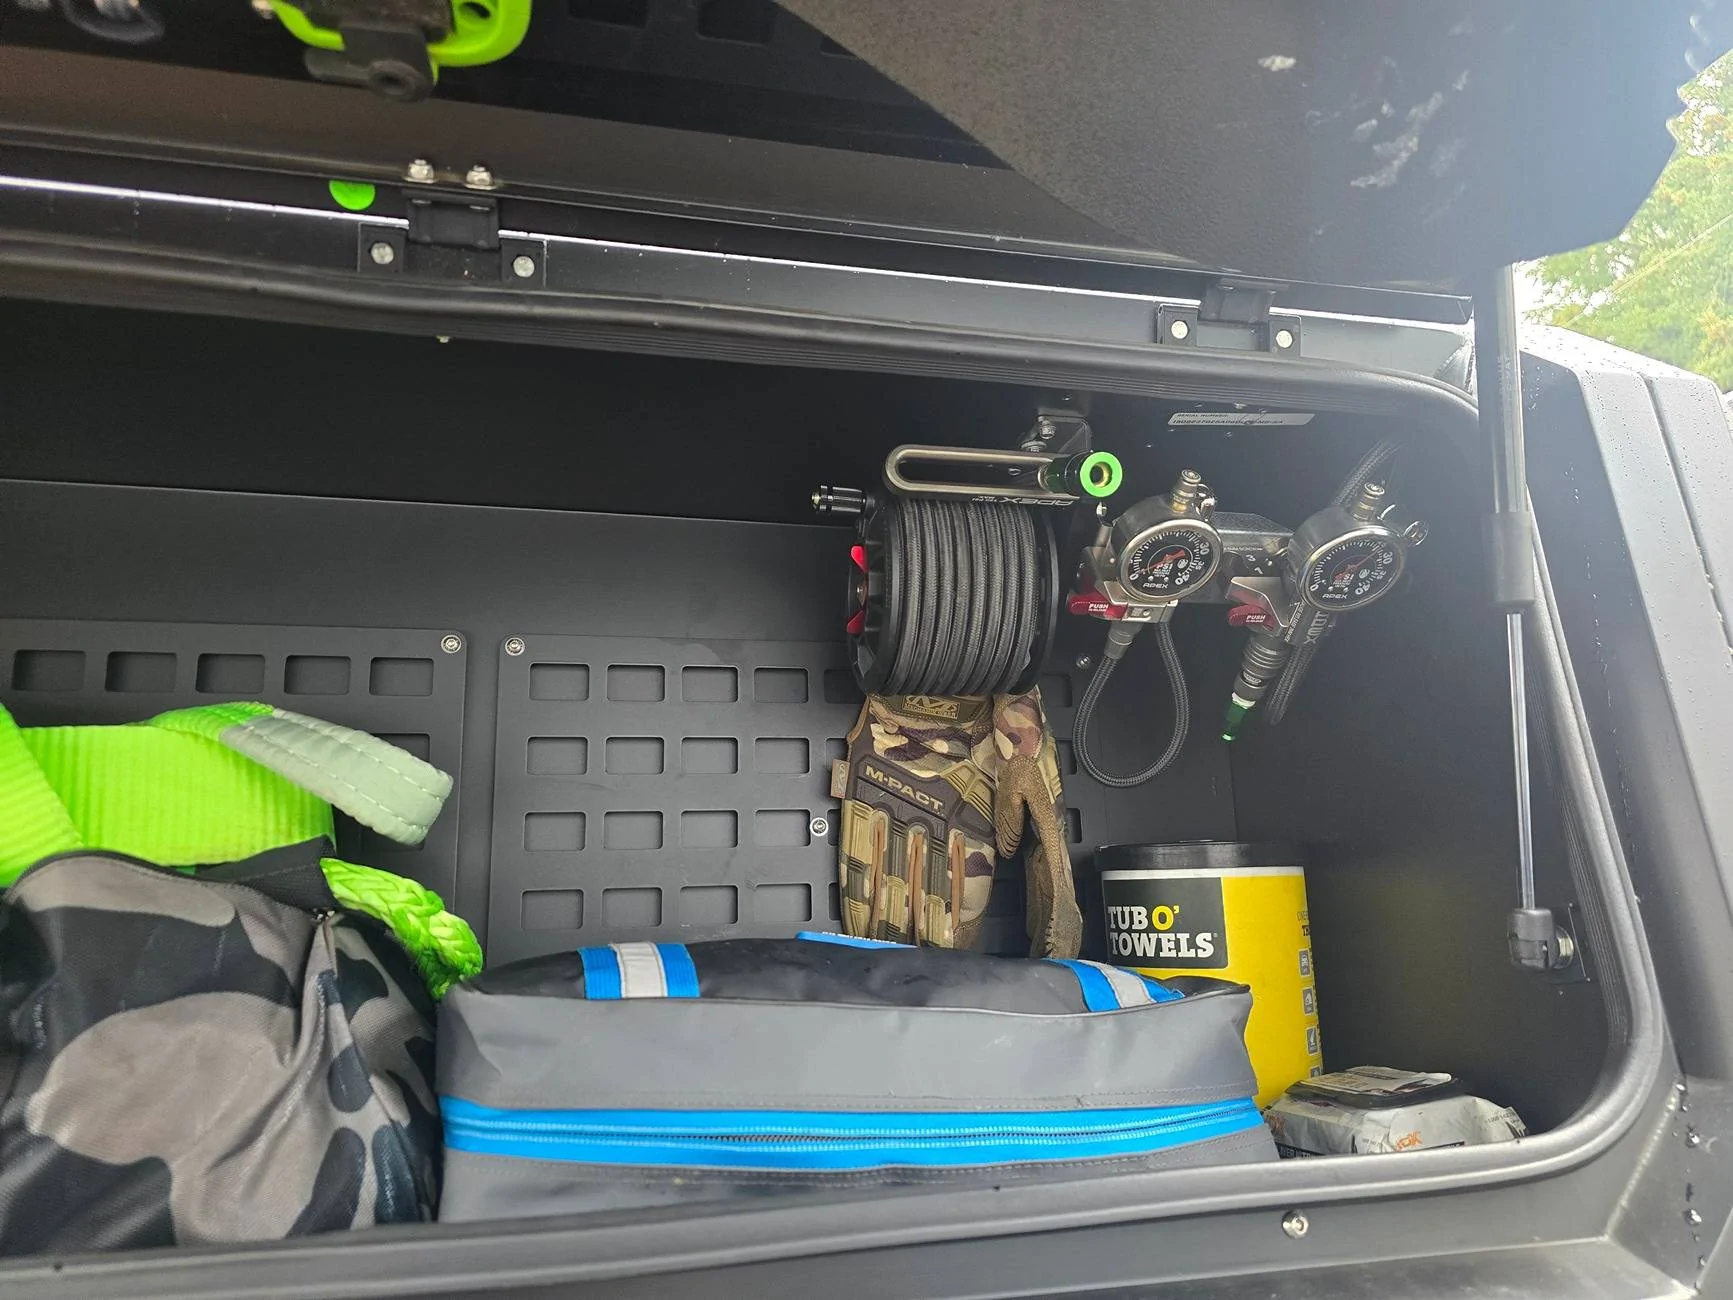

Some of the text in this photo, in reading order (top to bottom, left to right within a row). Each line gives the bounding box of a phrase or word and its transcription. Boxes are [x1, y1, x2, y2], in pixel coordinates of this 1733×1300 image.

[1199, 541, 1210, 556] 30
[1382, 551, 1394, 565] 30
[1107, 906, 1149, 930] TUB
[1109, 932, 1215, 958] TOWELS
